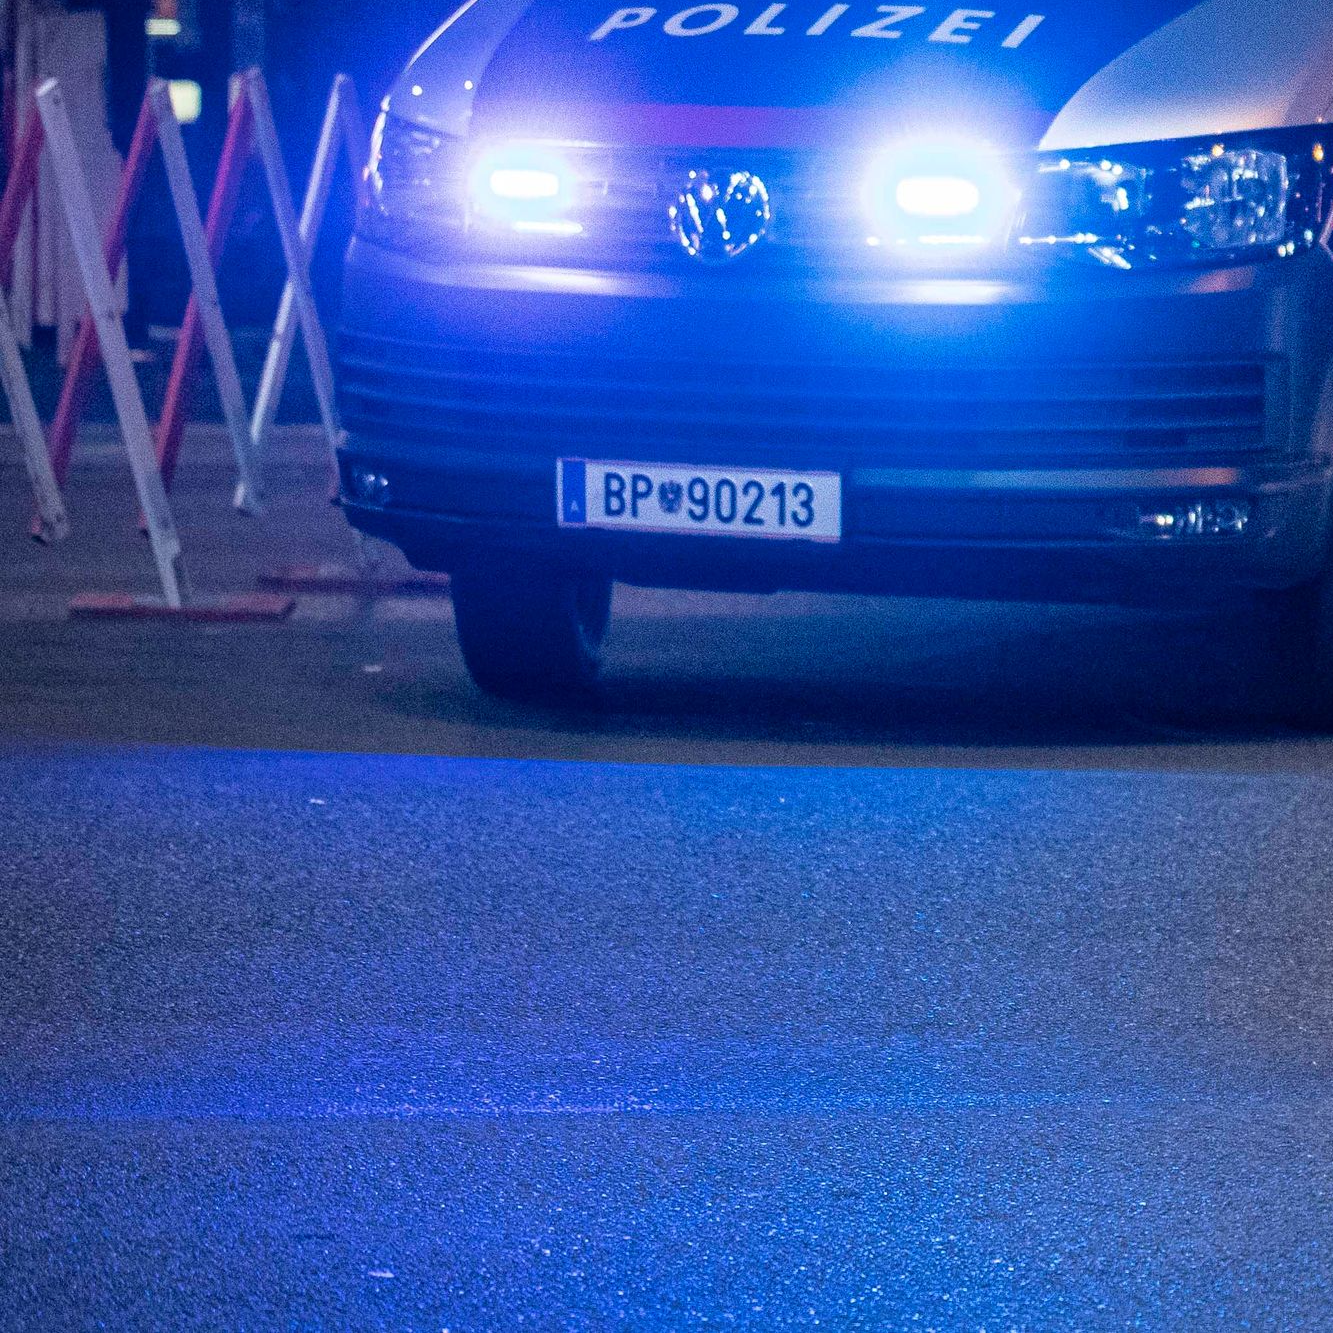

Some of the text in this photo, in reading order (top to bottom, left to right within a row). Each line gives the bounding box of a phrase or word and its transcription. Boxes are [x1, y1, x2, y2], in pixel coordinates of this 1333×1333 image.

[589, 1, 1047, 50] POLIZEI
[603, 470, 654, 519] BP
[686, 475, 816, 529] 90213
